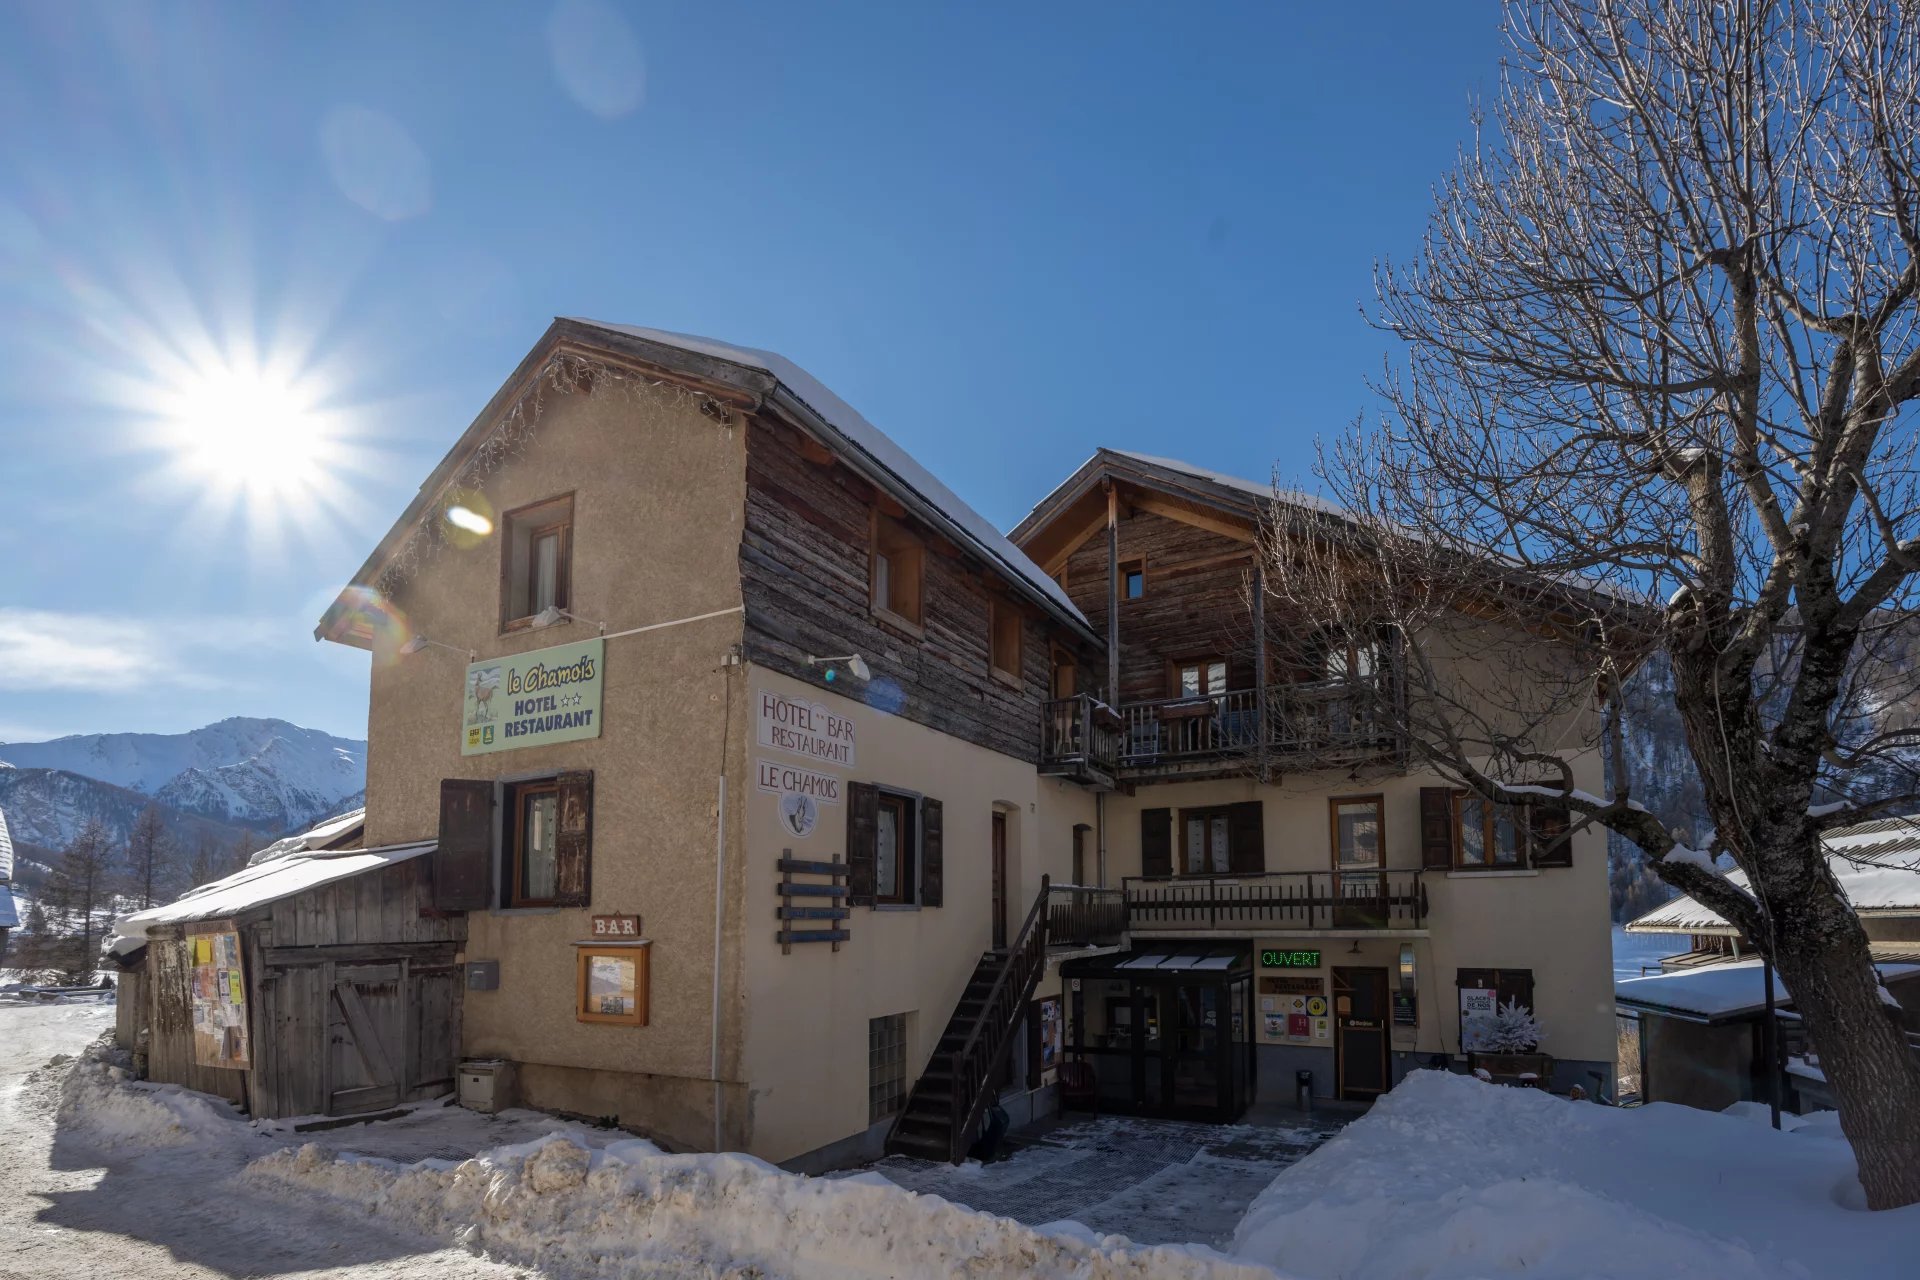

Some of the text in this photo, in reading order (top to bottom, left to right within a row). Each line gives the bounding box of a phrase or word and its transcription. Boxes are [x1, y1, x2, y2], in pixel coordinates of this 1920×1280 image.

[507, 655, 596, 696] le Chamois
[515, 695, 557, 716] HOTEL
[763, 695, 854, 743] HOTEL BAR
[504, 709, 593, 738] RESTAURANT
[771, 726, 849, 762] RESTAURANT
[760, 765, 837, 799] LE CHAMOIS
[595, 919, 635, 934] BAR
[1262, 952, 1319, 965] OUVERT
[1299, 1018, 1306, 1027] H
